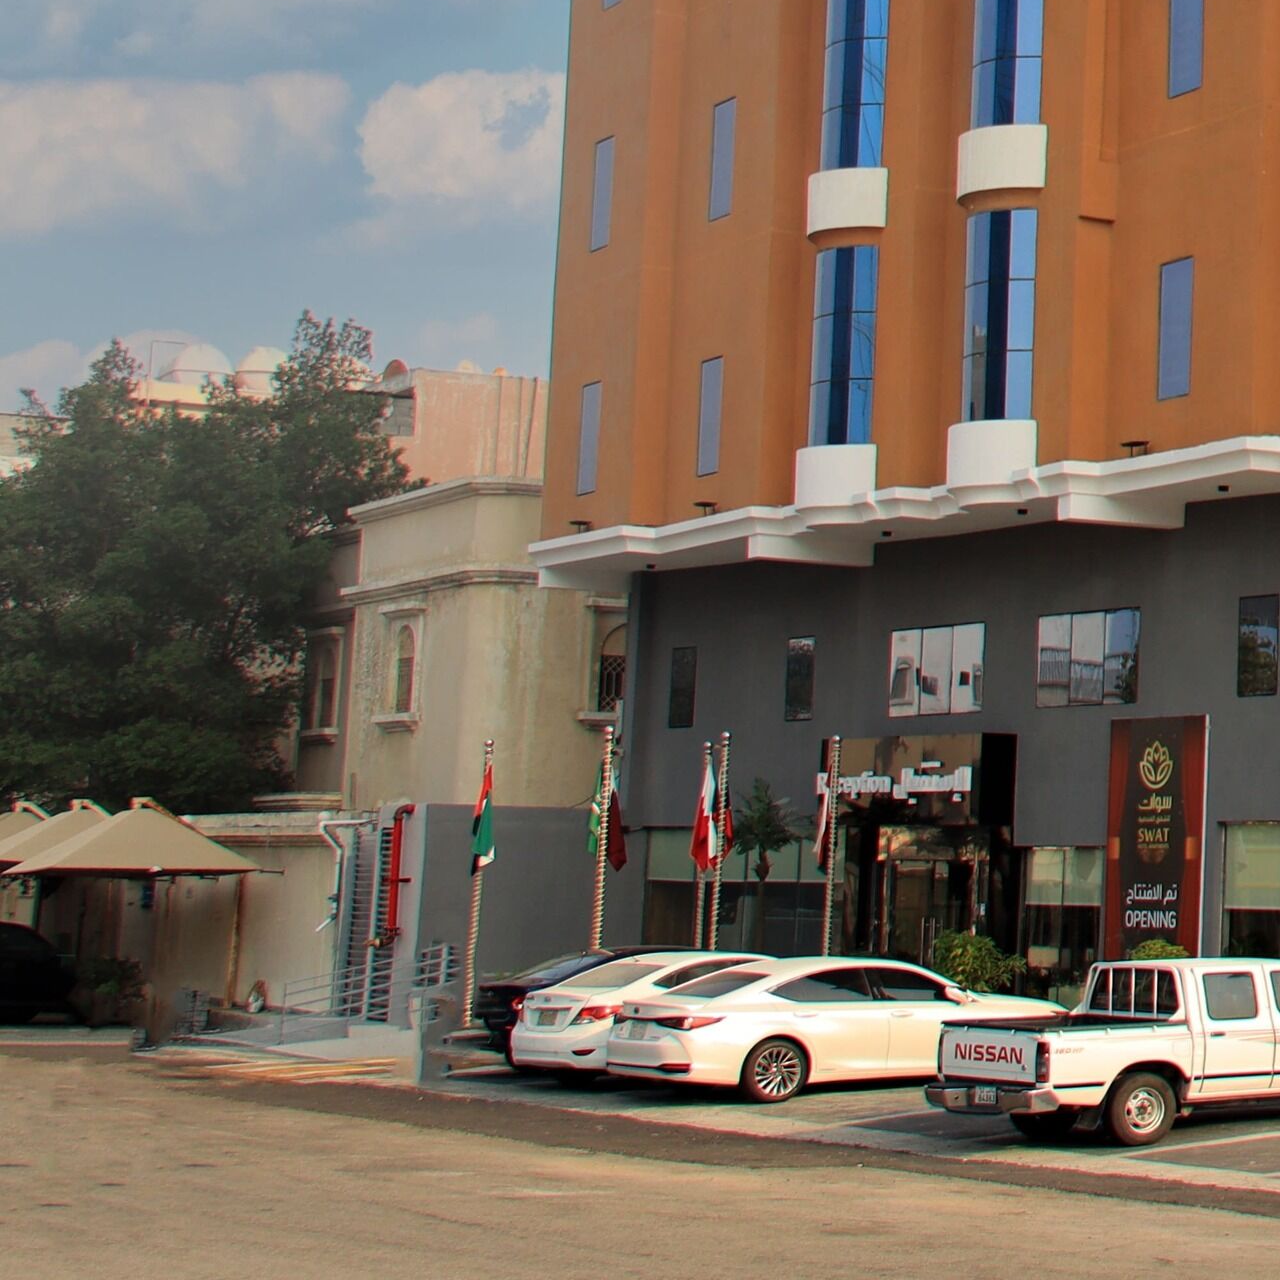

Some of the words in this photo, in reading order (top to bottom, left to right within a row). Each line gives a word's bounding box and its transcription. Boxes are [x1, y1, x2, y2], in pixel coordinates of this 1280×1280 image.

[816, 771, 892, 799] Rception
[1138, 792, 1172, 813] سوات
[1138, 827, 1170, 842] SWAT
[1163, 884, 1178, 905] تم
[1125, 910, 1177, 929] OPENING
[954, 1042, 1023, 1065] NISSAN
